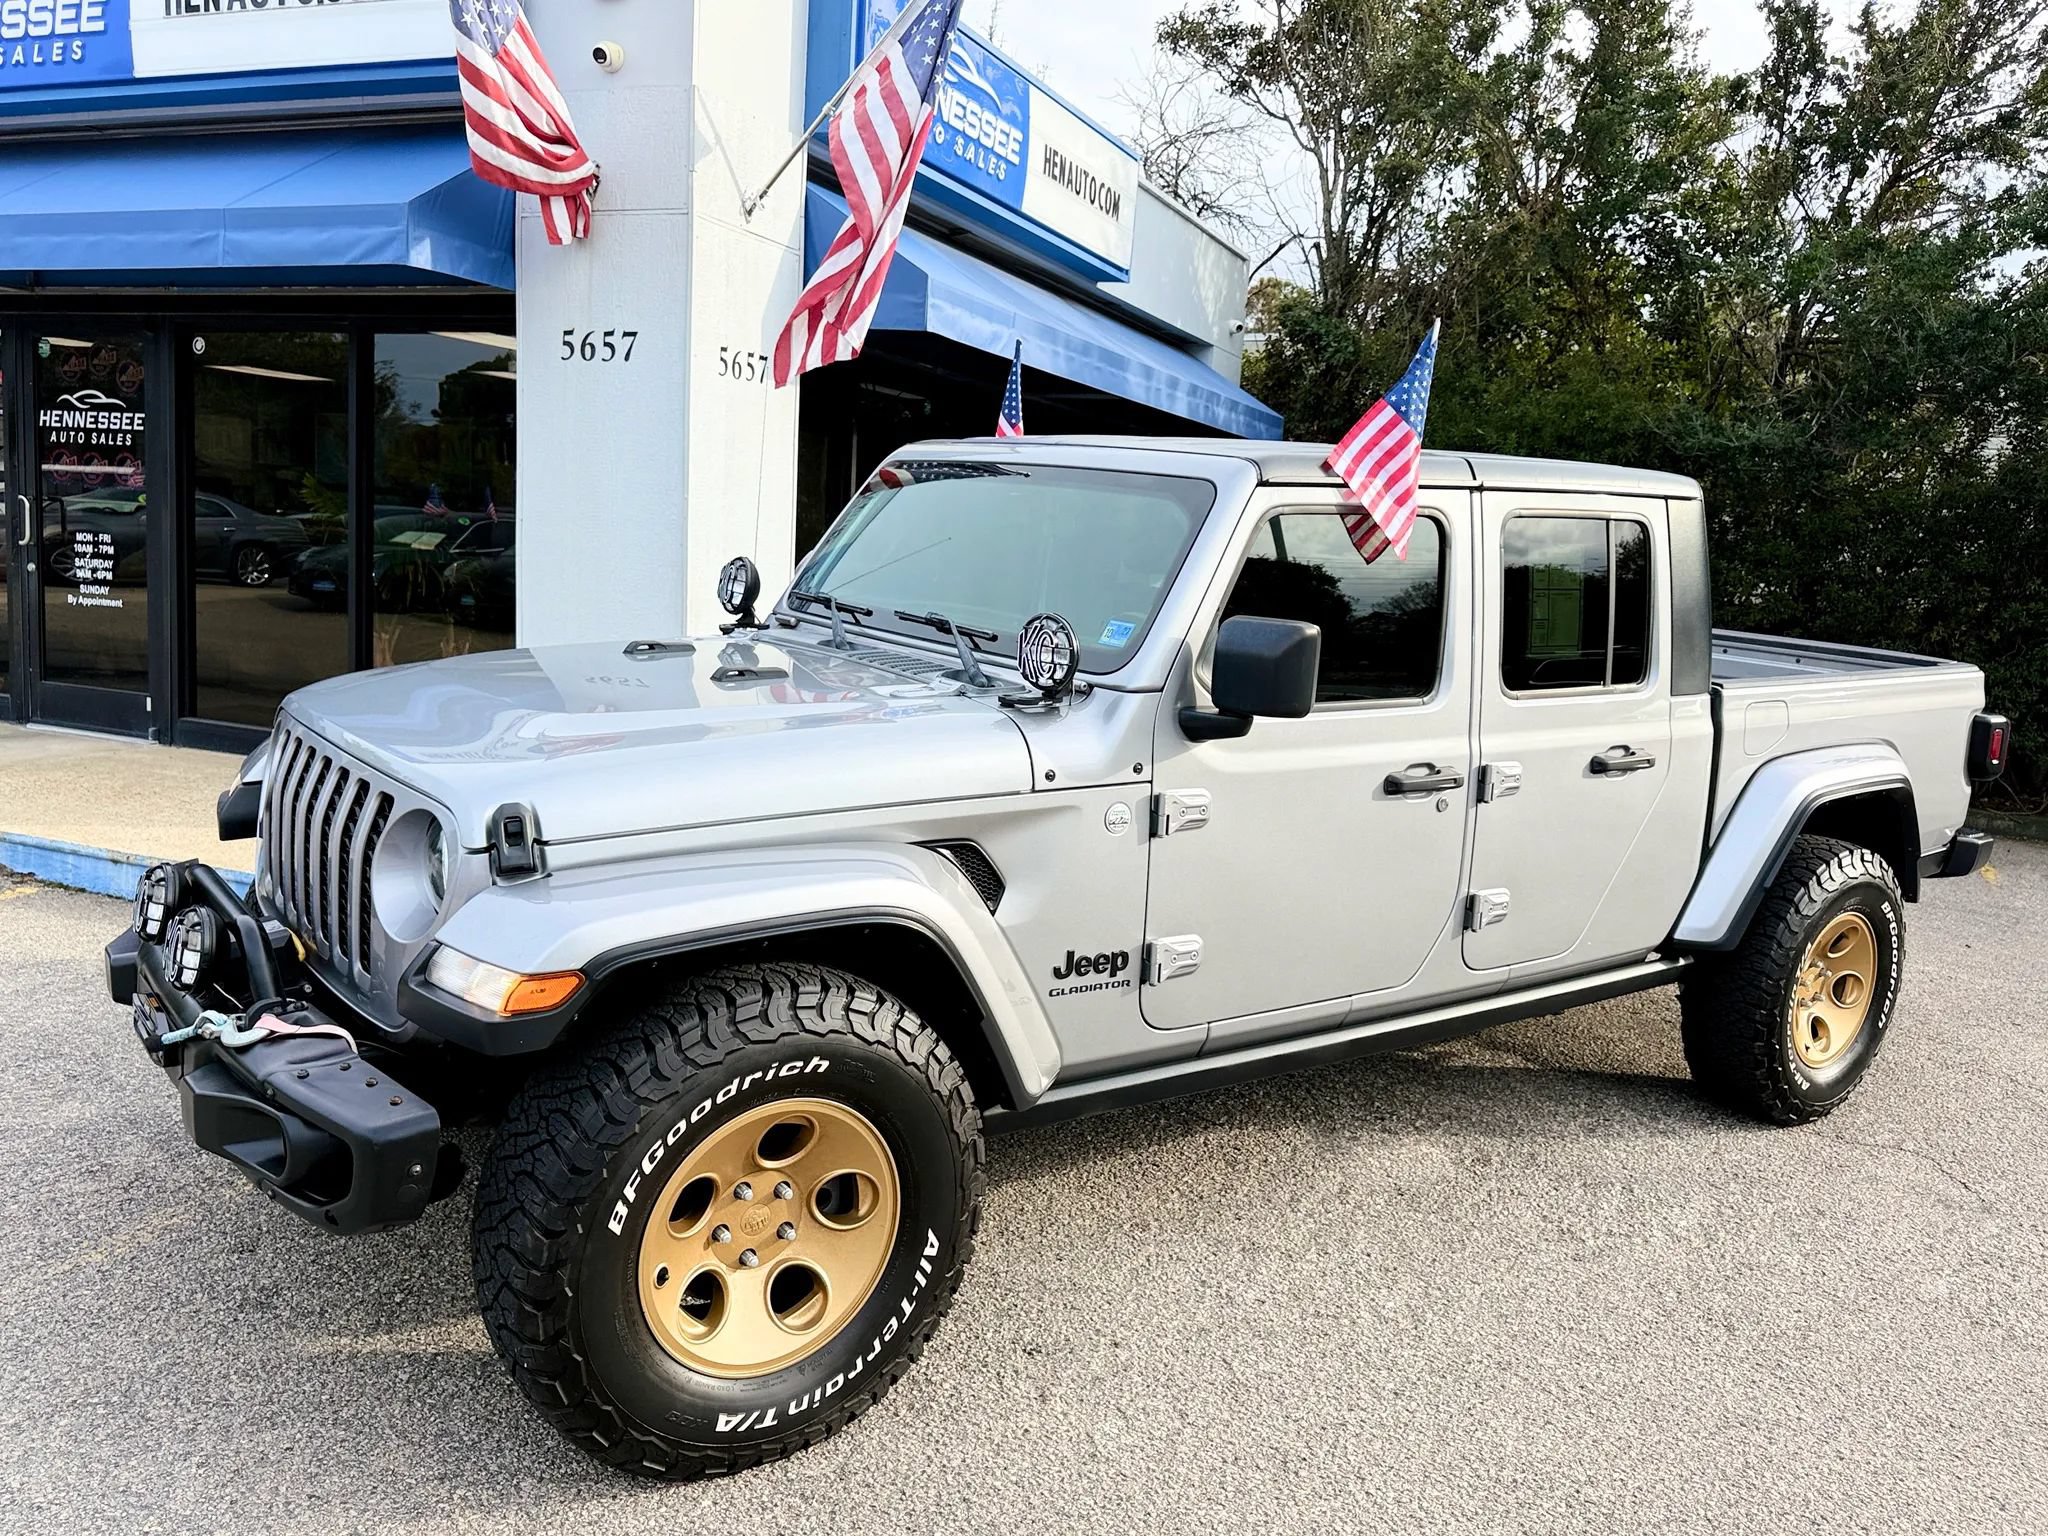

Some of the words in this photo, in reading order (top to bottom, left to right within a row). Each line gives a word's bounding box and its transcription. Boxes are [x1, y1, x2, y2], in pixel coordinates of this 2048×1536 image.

[0, 0, 105, 38] SSEE
[954, 135, 1007, 181] SALES
[560, 328, 639, 362] 5657
[718, 346, 768, 384] 5657
[39, 410, 146, 430] HENNESSEE
[50, 430, 85, 443] AUTO
[91, 432, 132, 446] SALES
[73, 543, 93, 553] 10AM
[98, 545, 115, 555] 7PM
[75, 532, 93, 542] MON
[98, 533, 112, 544] FRI
[74, 557, 114, 569] SATURDAY
[67, 594, 77, 606] By
[78, 595, 123, 608] Appointment
[80, 584, 110, 595] SUNDAY
[1017, 623, 1055, 683] KC
[1053, 949, 1129, 980] Jeep
[1878, 901, 1898, 1029] BFGoodrich
[1048, 979, 1131, 997] GLADIATOR
[608, 1056, 830, 1236] BFGoodrich
[788, 1228, 939, 1415] All-Terrain
[715, 1407, 779, 1432] T/A
